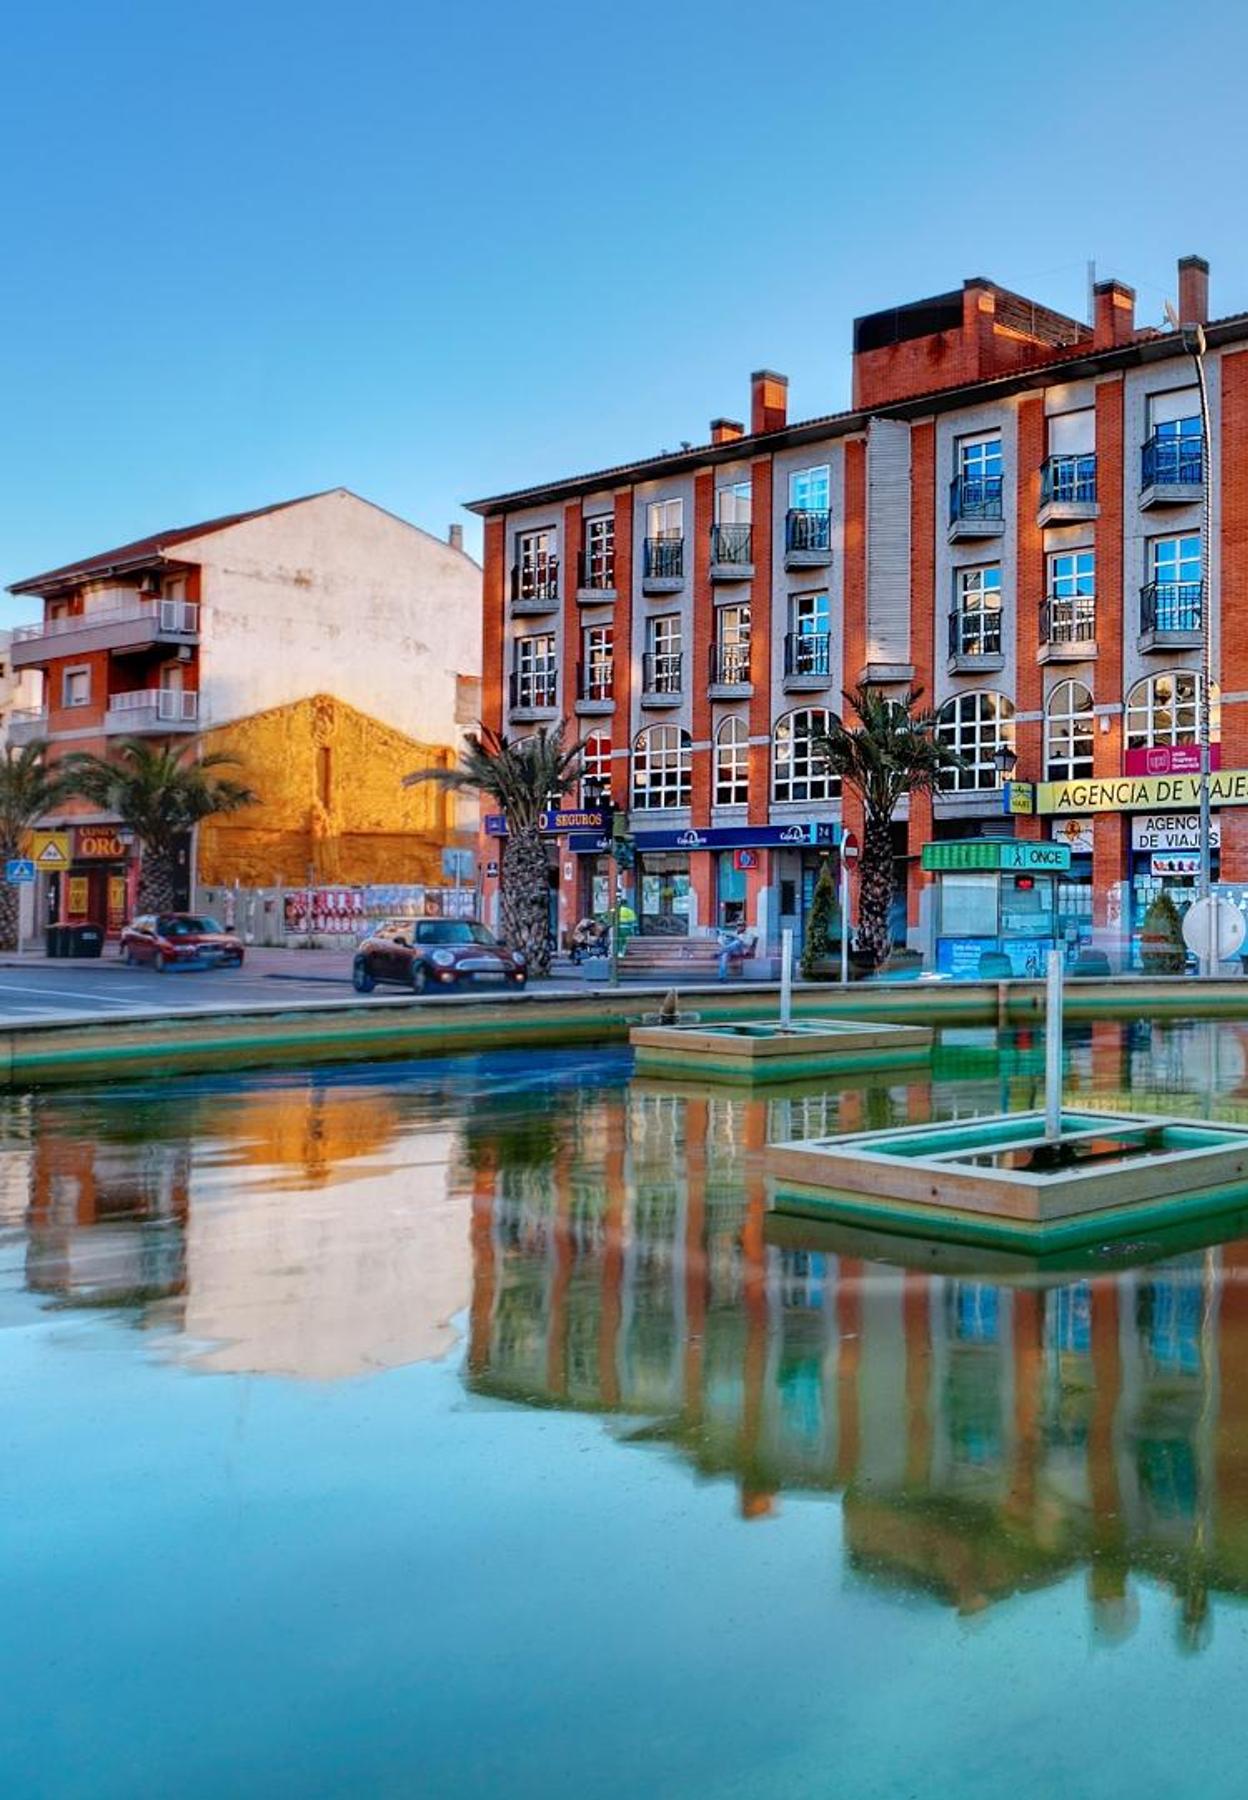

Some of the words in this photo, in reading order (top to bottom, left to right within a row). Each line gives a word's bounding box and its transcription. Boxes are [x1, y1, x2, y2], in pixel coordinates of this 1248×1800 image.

[1058, 783, 1149, 807] AGENCIA
[1156, 780, 1183, 801] DE
[556, 813, 602, 826] SEGUROS
[1146, 815, 1212, 831] AGENCI
[82, 838, 125, 855] ORO
[1139, 835, 1159, 848] DE
[1165, 832, 1219, 847] VIAJS
[1030, 850, 1062, 864] ONCE
